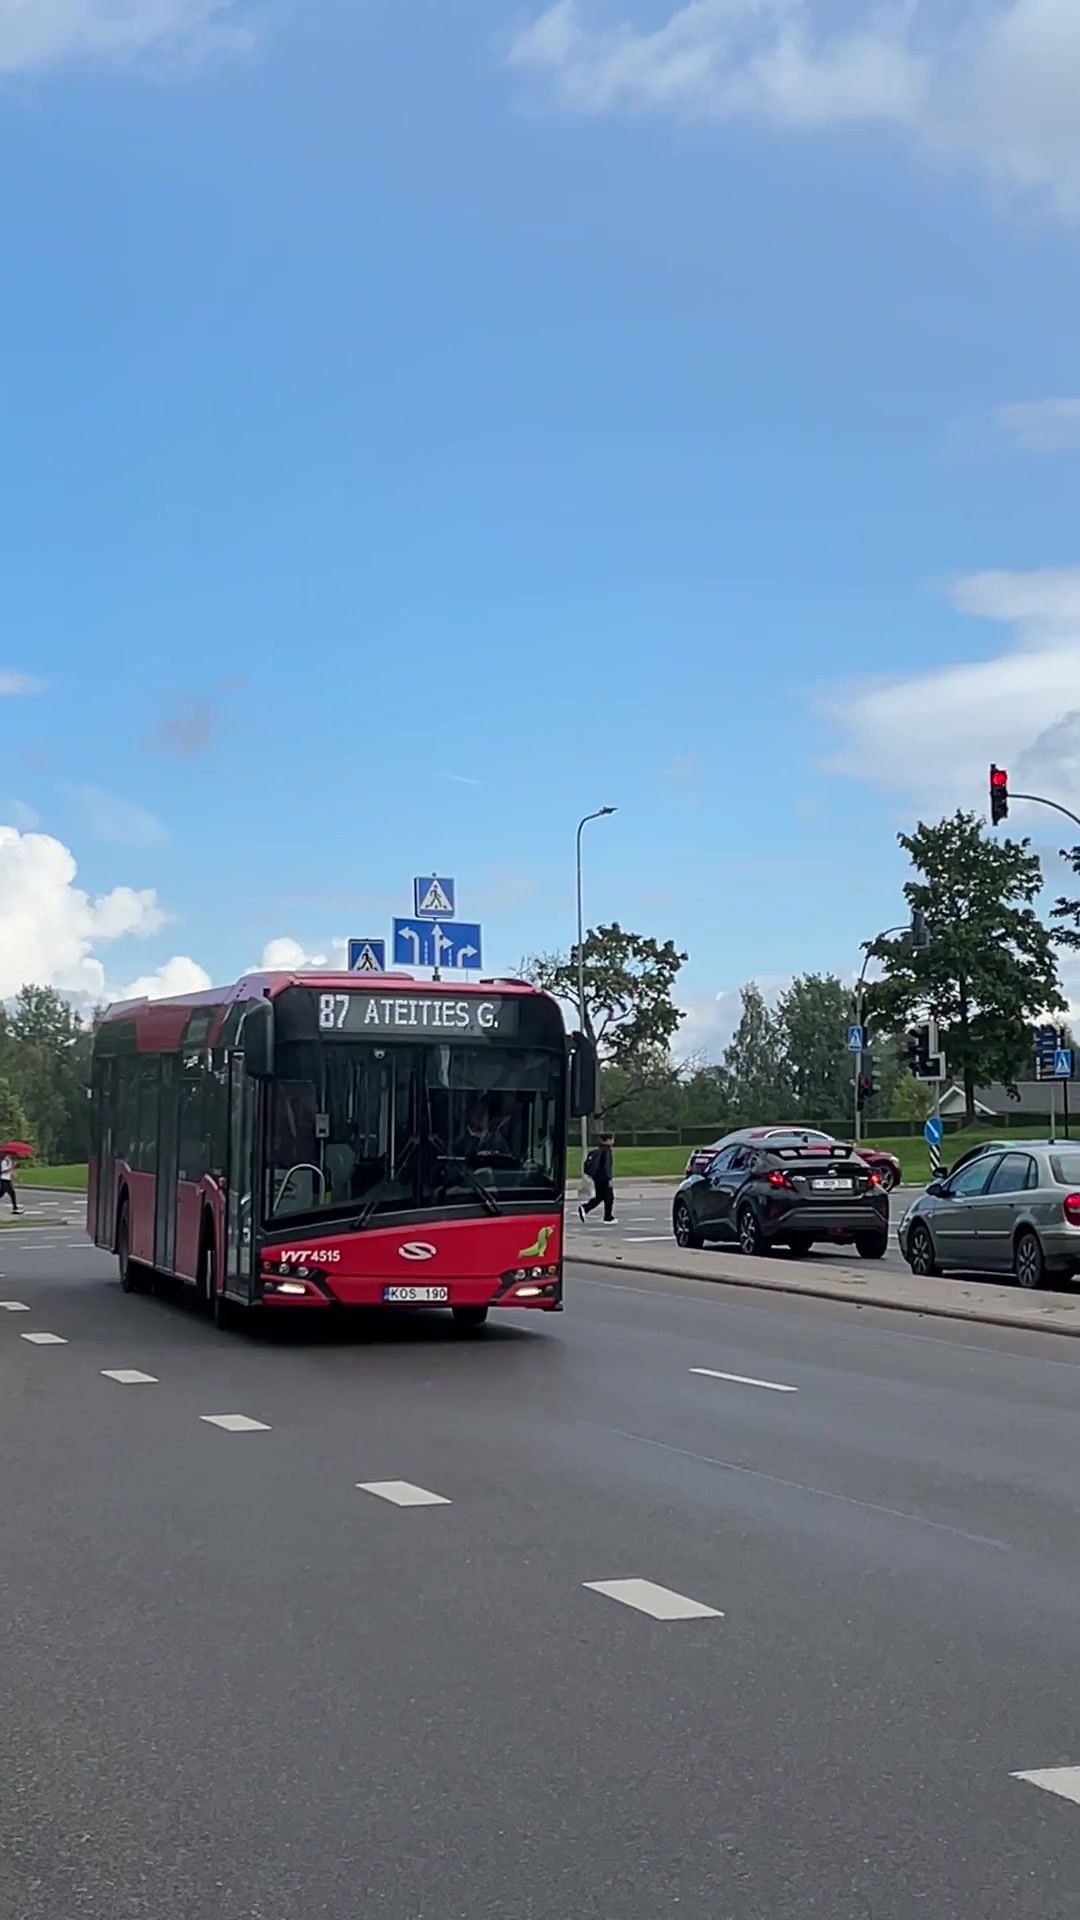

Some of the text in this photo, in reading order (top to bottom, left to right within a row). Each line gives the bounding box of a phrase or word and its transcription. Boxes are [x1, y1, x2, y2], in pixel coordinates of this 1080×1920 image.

[319, 994, 499, 1028] 87 ATEITIES G.
